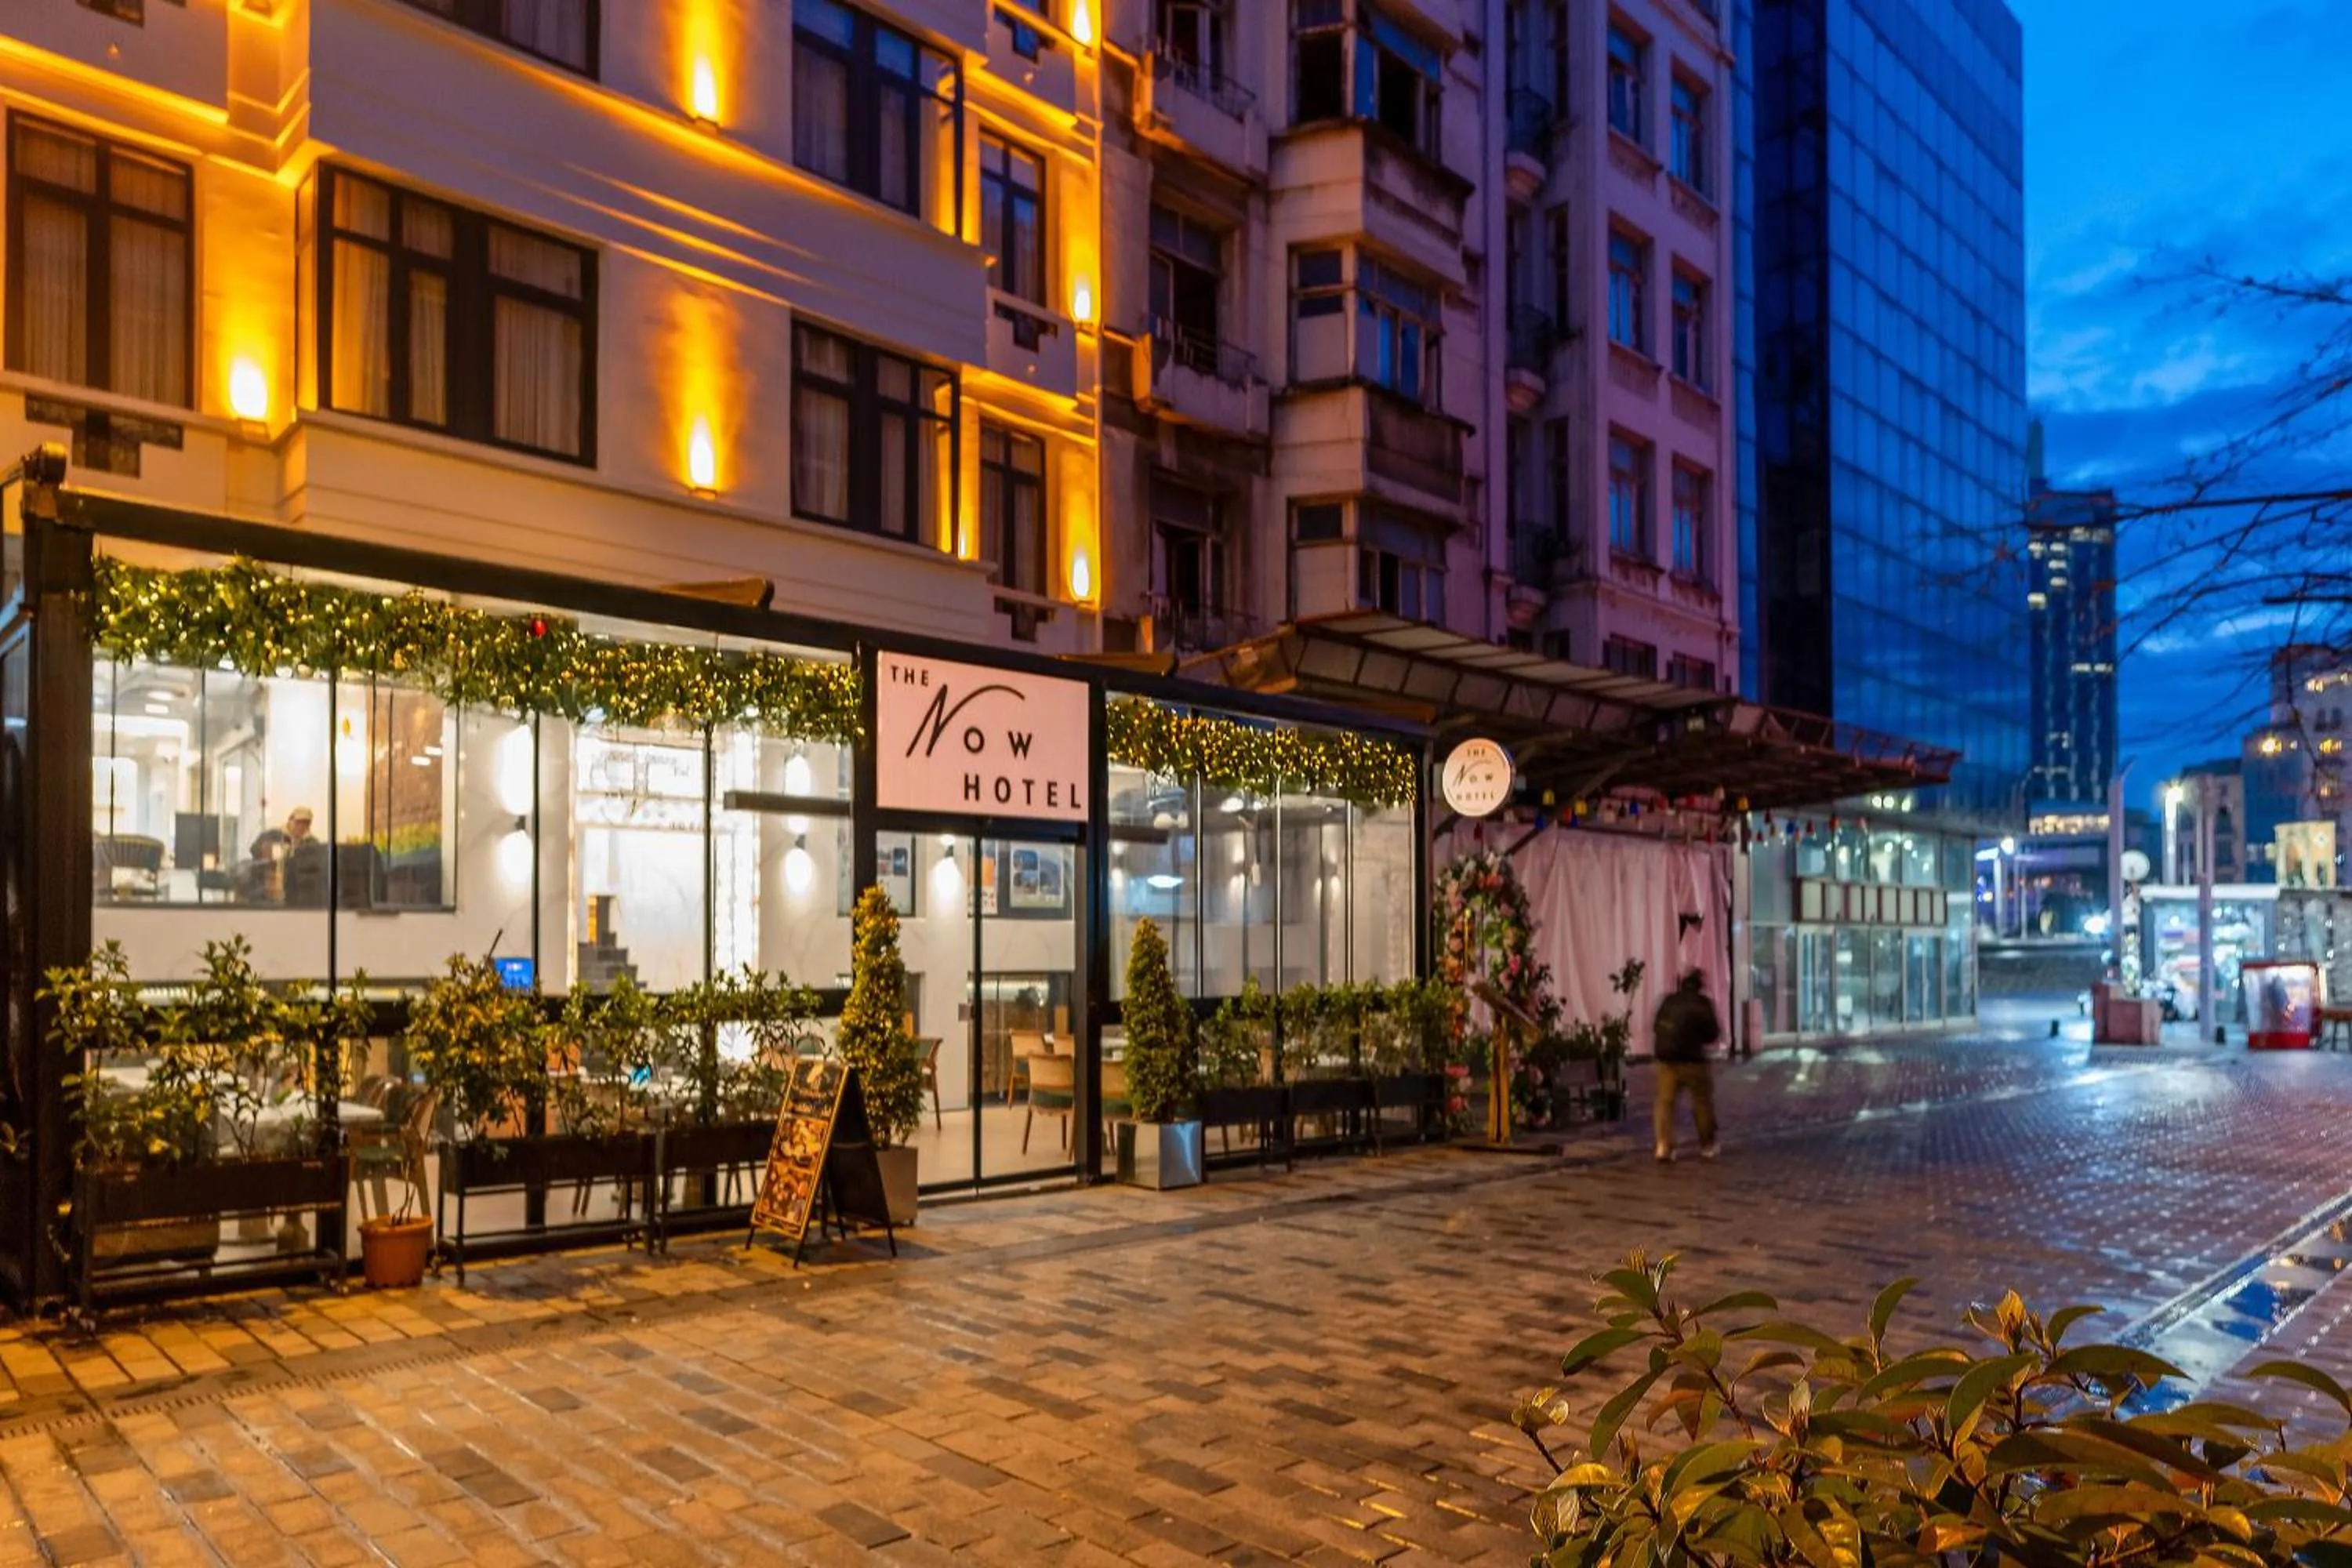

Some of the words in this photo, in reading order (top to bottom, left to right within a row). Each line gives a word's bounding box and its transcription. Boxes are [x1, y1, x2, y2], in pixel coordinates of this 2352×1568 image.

[891, 665, 929, 687] THE
[905, 684, 1032, 760] NOW
[1452, 760, 1494, 787] NOW
[964, 773, 1081, 809] HOTEL
